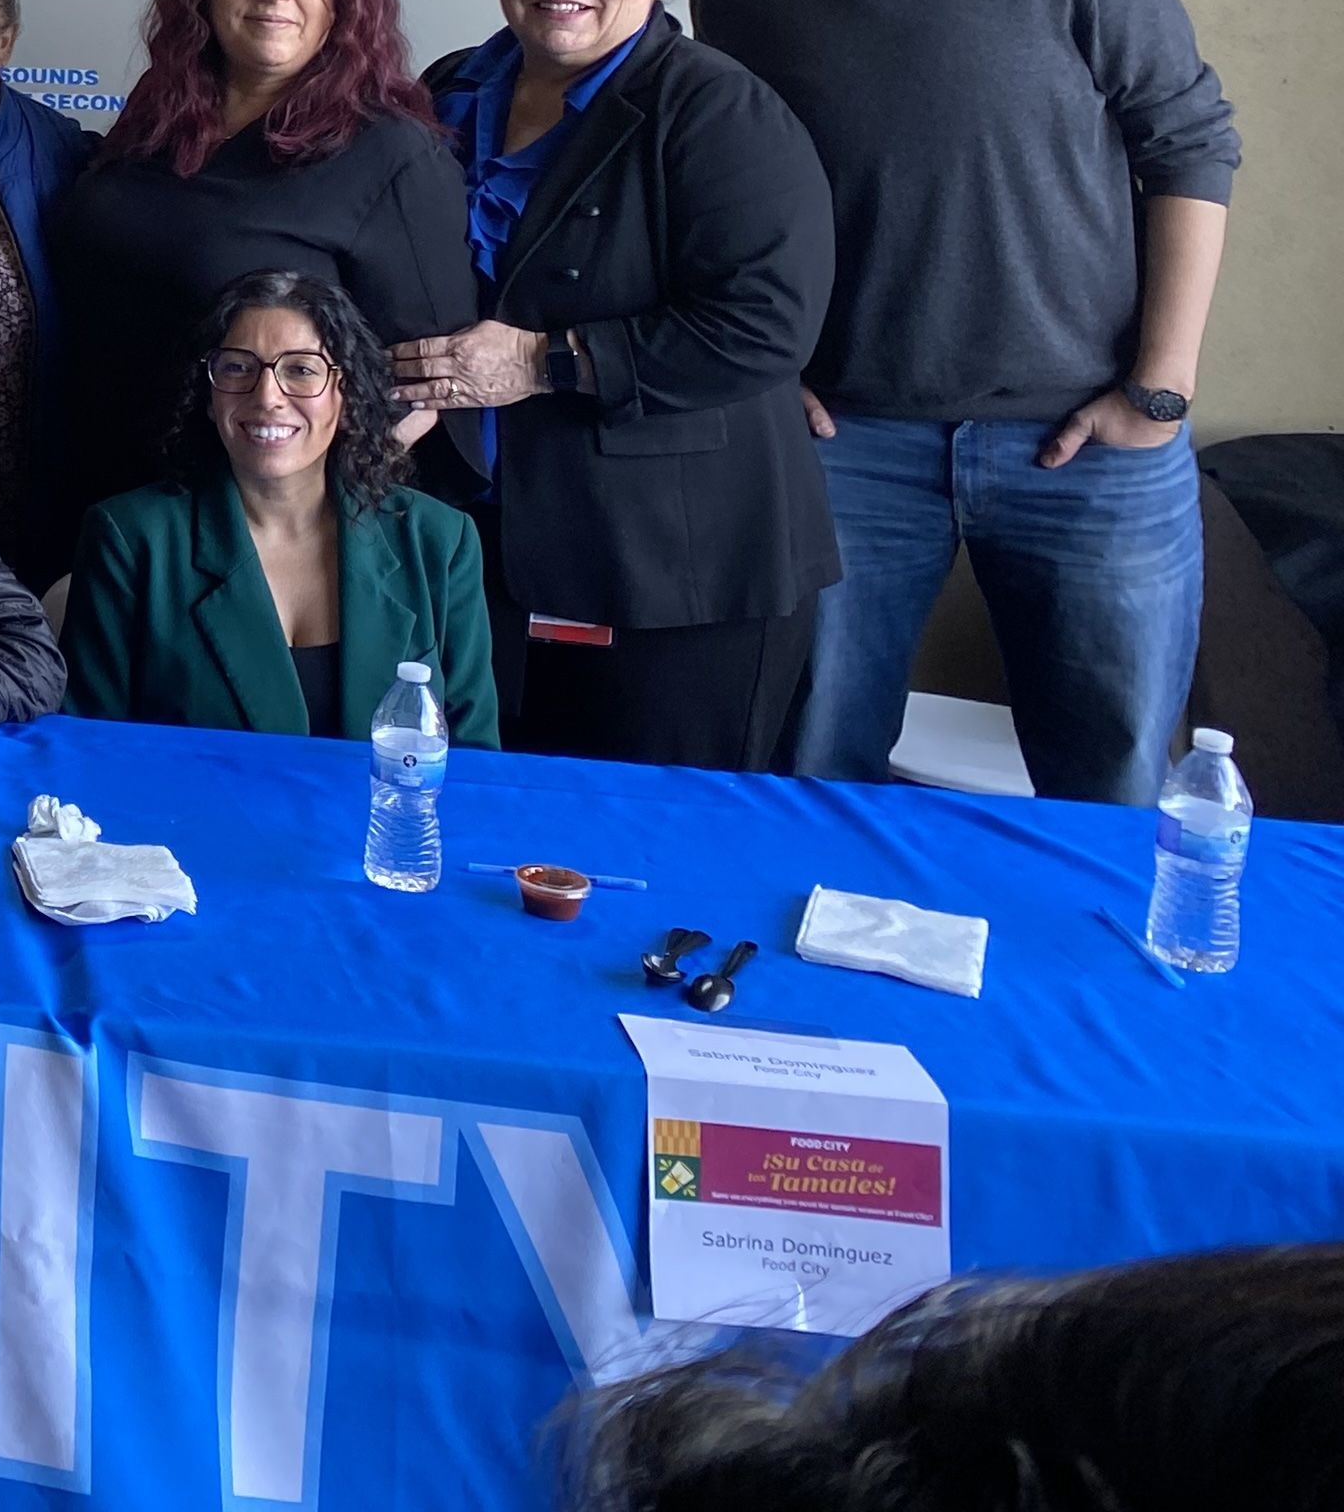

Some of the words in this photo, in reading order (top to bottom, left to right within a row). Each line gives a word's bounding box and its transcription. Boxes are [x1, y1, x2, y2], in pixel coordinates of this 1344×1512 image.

[0, 68, 99, 85] SOUNDS
[42, 94, 126, 110] SECON
[688, 1048, 762, 1064] Sabrina
[768, 1057, 877, 1076] Dominguez
[791, 1137, 821, 1150] FOOD
[823, 1139, 851, 1153] CITY
[806, 1155, 866, 1173] Casa
[770, 1173, 896, 1196] Tamales!
[702, 1231, 775, 1253] Sabrina
[782, 1238, 893, 1266] Dominguez
[762, 1257, 796, 1273] Food
[801, 1260, 830, 1278] City
